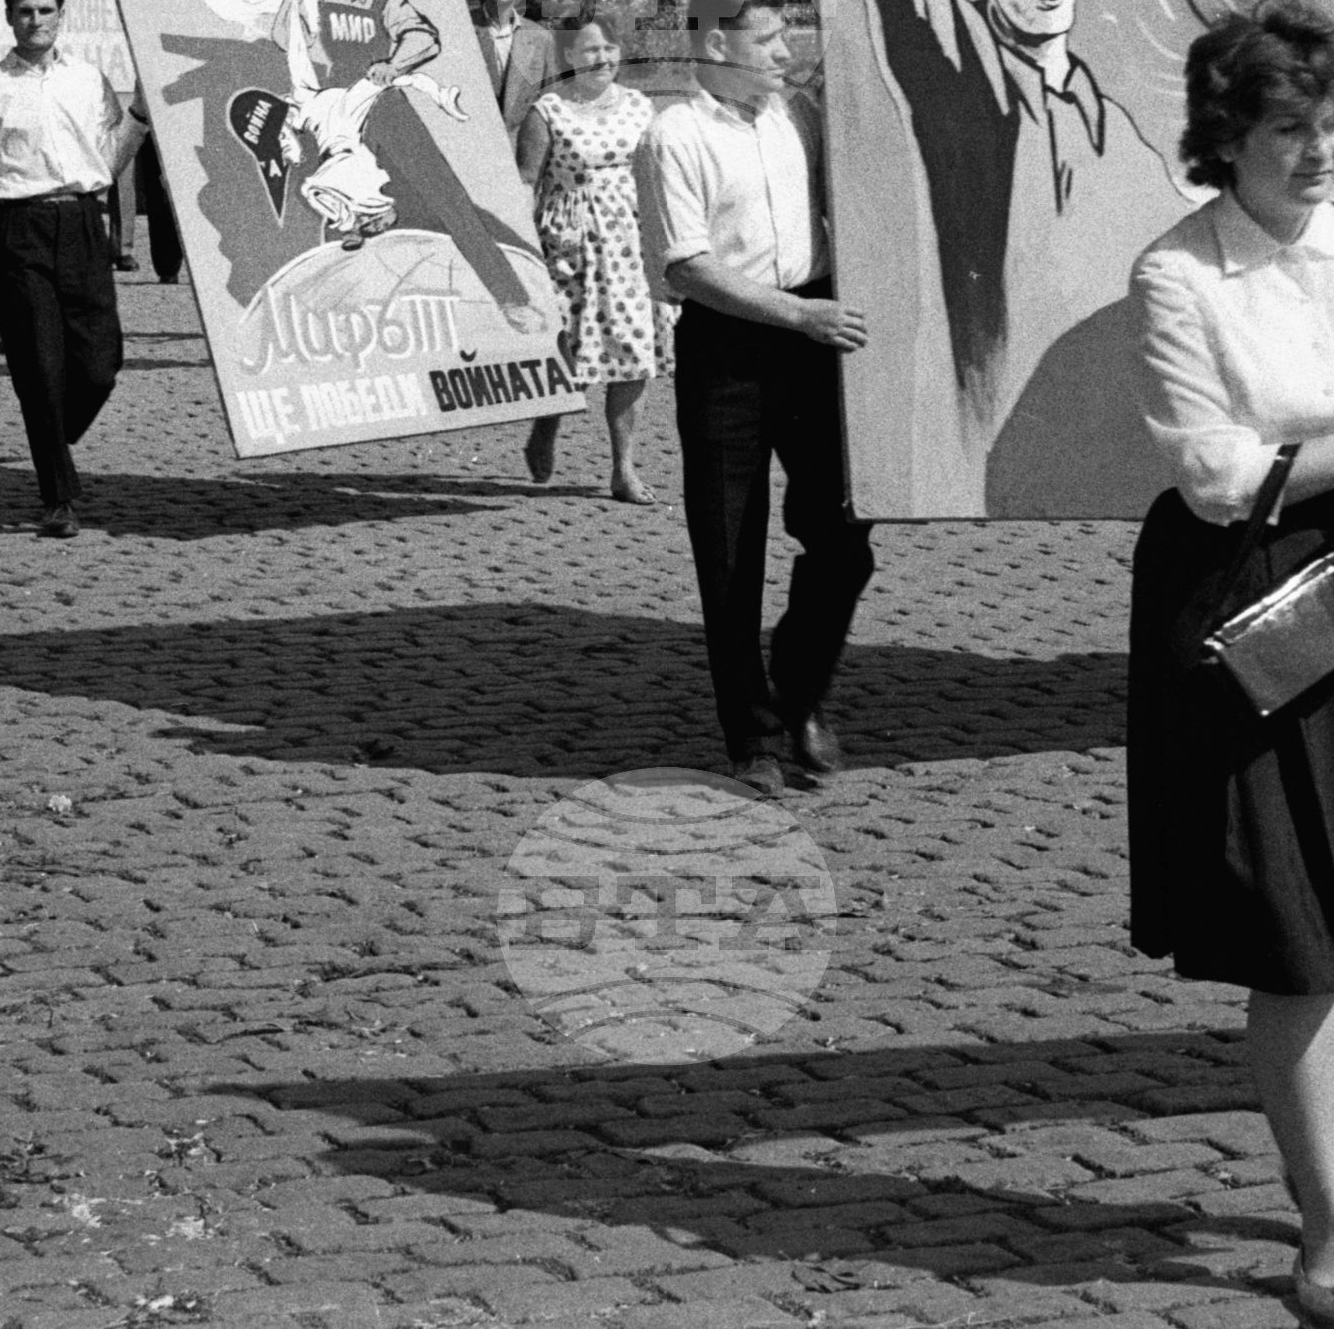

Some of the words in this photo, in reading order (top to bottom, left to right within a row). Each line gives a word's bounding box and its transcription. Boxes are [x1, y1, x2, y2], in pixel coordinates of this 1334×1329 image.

[329, 12, 376, 44] МИР
[243, 99, 273, 145] ВОЙНА
[236, 386, 302, 445] ЩЕ
[299, 372, 428, 433] ПОБЕДИ
